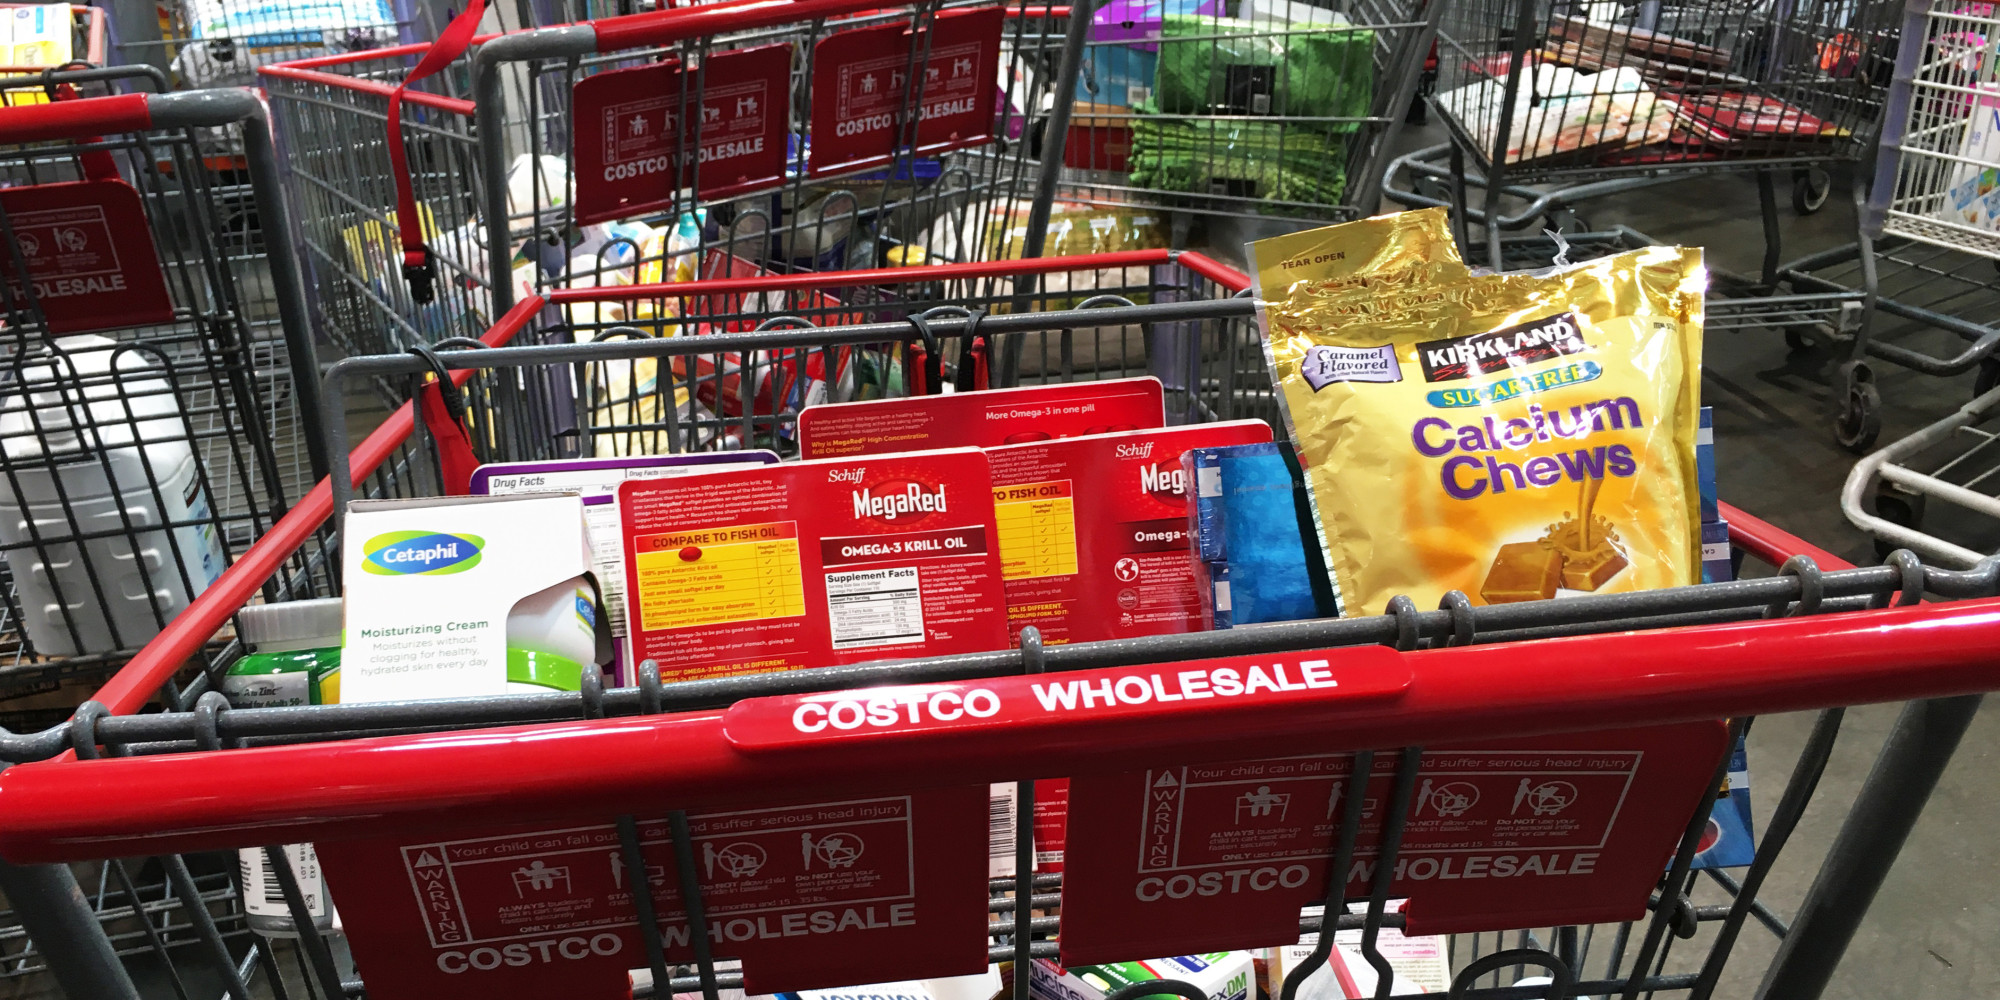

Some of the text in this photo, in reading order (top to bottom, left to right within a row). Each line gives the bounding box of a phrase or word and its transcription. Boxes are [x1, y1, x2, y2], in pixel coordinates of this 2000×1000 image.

[836, 114, 891, 137] COSTCO
[604, 156, 667, 181] COSTCO
[1281, 252, 1345, 269] TEAR OPEN
[0, 274, 127, 302] HOLESALE
[1427, 320, 1573, 367] KIRKLAND
[1318, 349, 1383, 361] Caramel
[1320, 359, 1388, 375] Flavored
[1443, 366, 1581, 406] SUGAR FREE
[986, 412, 1008, 420] More
[1010, 408, 1051, 420] Omega-3
[1081, 404, 1095, 415] pill
[1411, 397, 1643, 458] Calcium
[1115, 442, 1154, 458] Schiff
[494, 477, 545, 488] Drug Facts
[828, 468, 866, 483] Schiff
[1140, 463, 1187, 494] Meg
[1441, 444, 1636, 500] Chews
[852, 483, 947, 520] MegaRed
[1010, 487, 1037, 499] FISH
[1040, 486, 1061, 496] OIL
[653, 527, 779, 548] COMPARE TO FISH OIL
[842, 537, 967, 557] OMEGA-3 KRILL OIL
[383, 543, 458, 564] Cetaphil
[828, 569, 914, 583] Supplement Facts
[361, 621, 488, 638] Moisturizing Cream
[373, 636, 477, 651] Moisturizes without
[370, 648, 479, 663] clogging for healthy,
[361, 658, 488, 676] hydrated skin every day
[259, 687, 277, 696] Zinc
[792, 658, 1337, 734] COSTCO WHOLESALE
[1193, 757, 1630, 780] Your child can fall out car nd suffer serious head injury
[453, 804, 902, 858] Your child can fall out car nd suffer serious head injury
[1150, 789, 1178, 867] WARNING
[1209, 830, 1254, 838] ALWAYS
[1135, 853, 1600, 902] COSTCO WHOLESALE
[417, 868, 460, 942] WARNING
[436, 902, 916, 974] COSTCO WHOLESALE
[1160, 958, 1189, 975] RESSANT
[1227, 971, 1247, 997] DM
